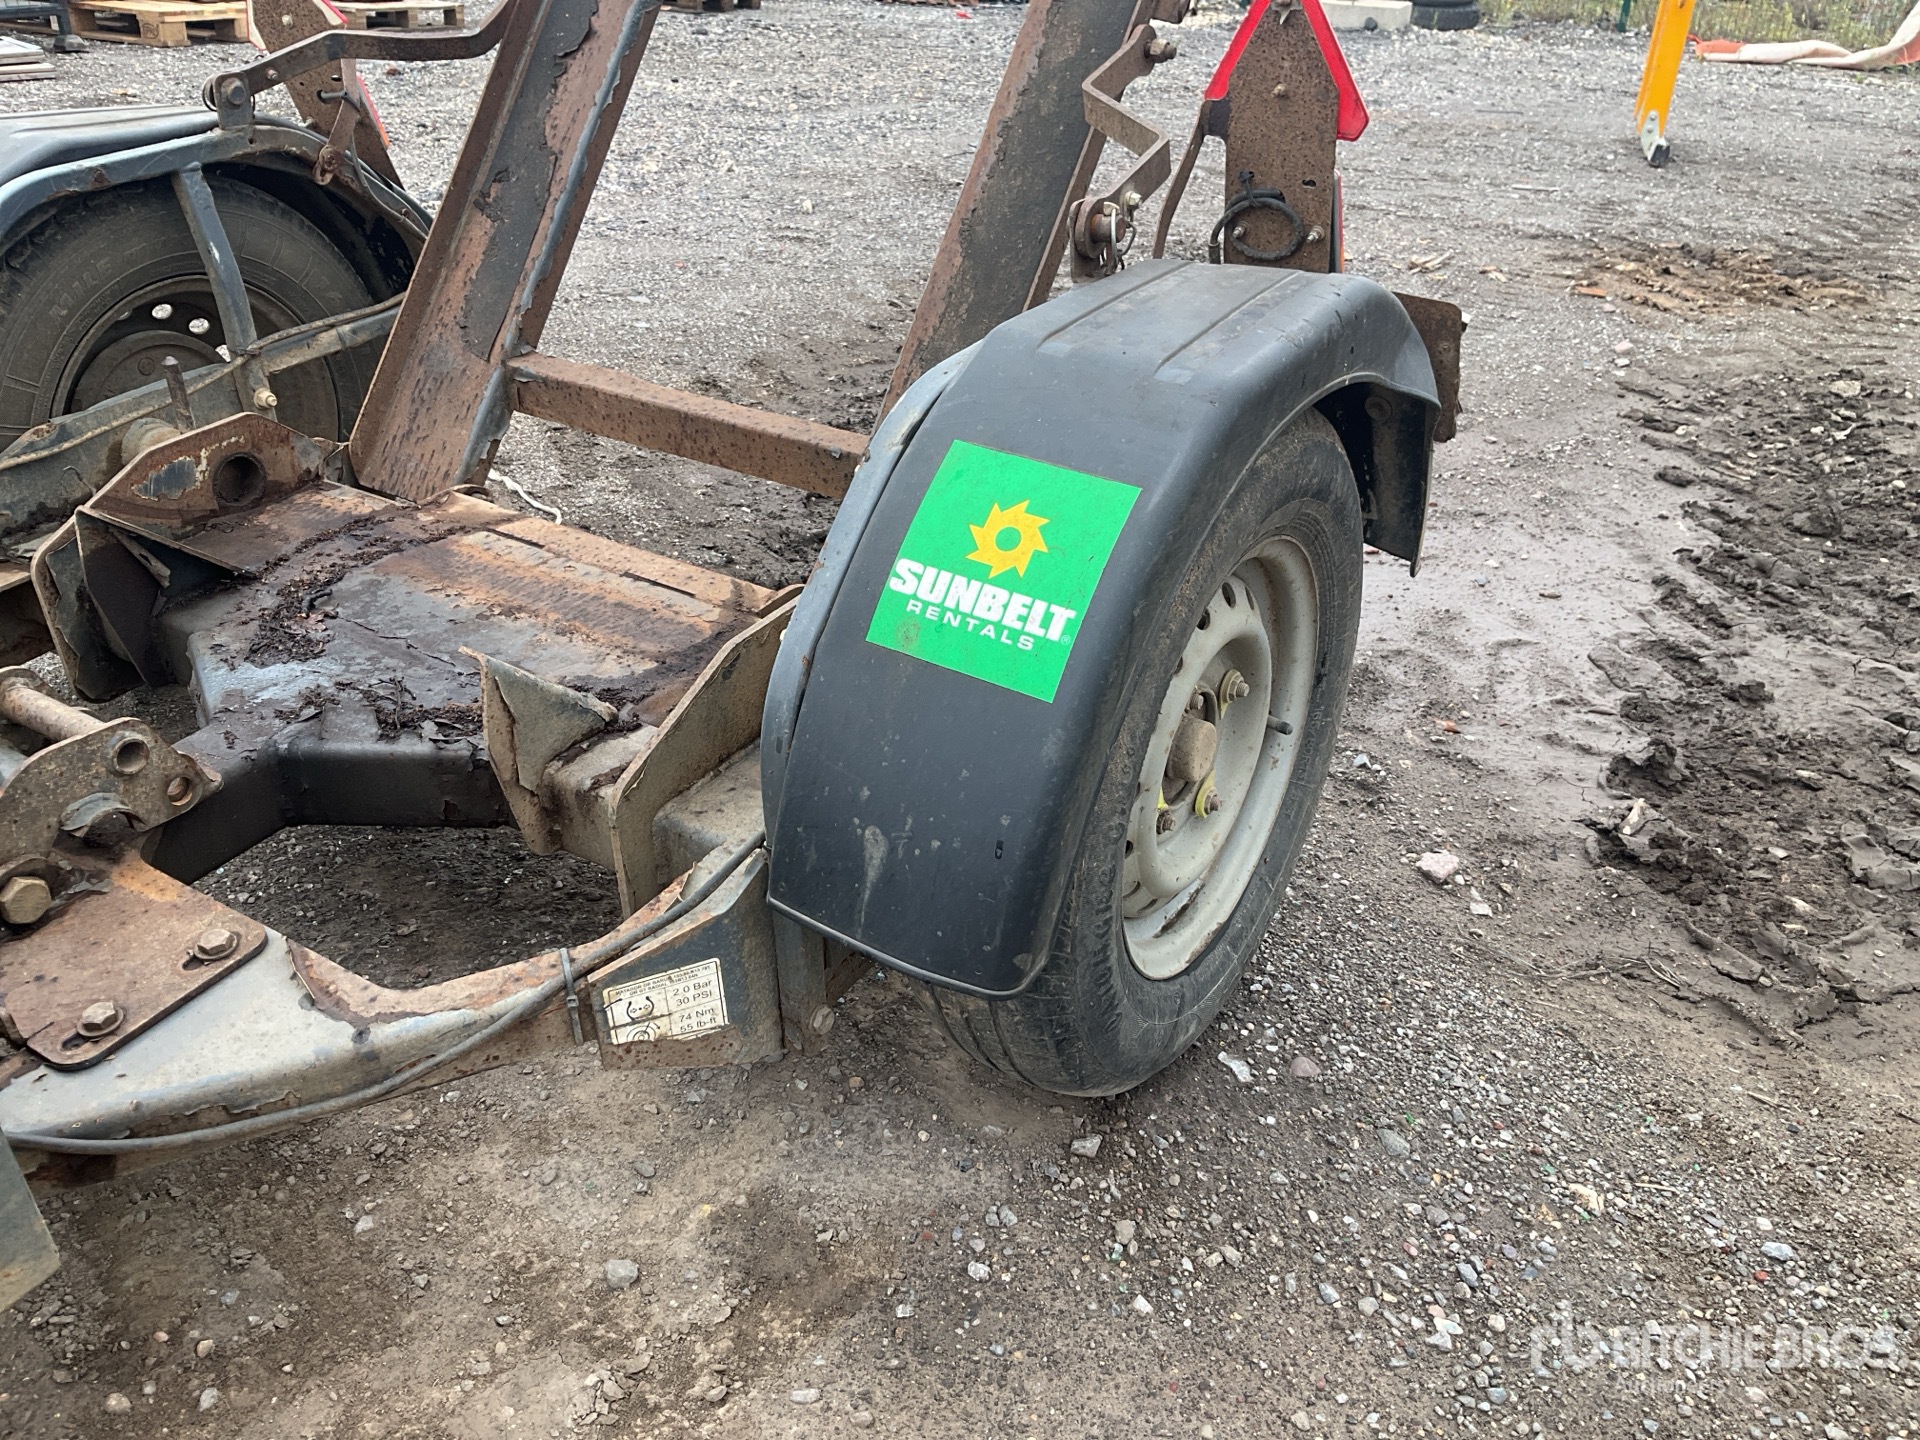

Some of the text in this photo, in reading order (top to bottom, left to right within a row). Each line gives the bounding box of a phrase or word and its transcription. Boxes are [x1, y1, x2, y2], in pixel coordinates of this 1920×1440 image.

[889, 558, 1077, 642] SUNBELT
[906, 599, 1035, 651] RENTALS
[673, 979, 712, 997] 2.0 Bar
[676, 990, 712, 1007] 30 PSI
[679, 1007, 715, 1023] 74 Nm
[681, 1016, 717, 1033] 55 lb-ft
